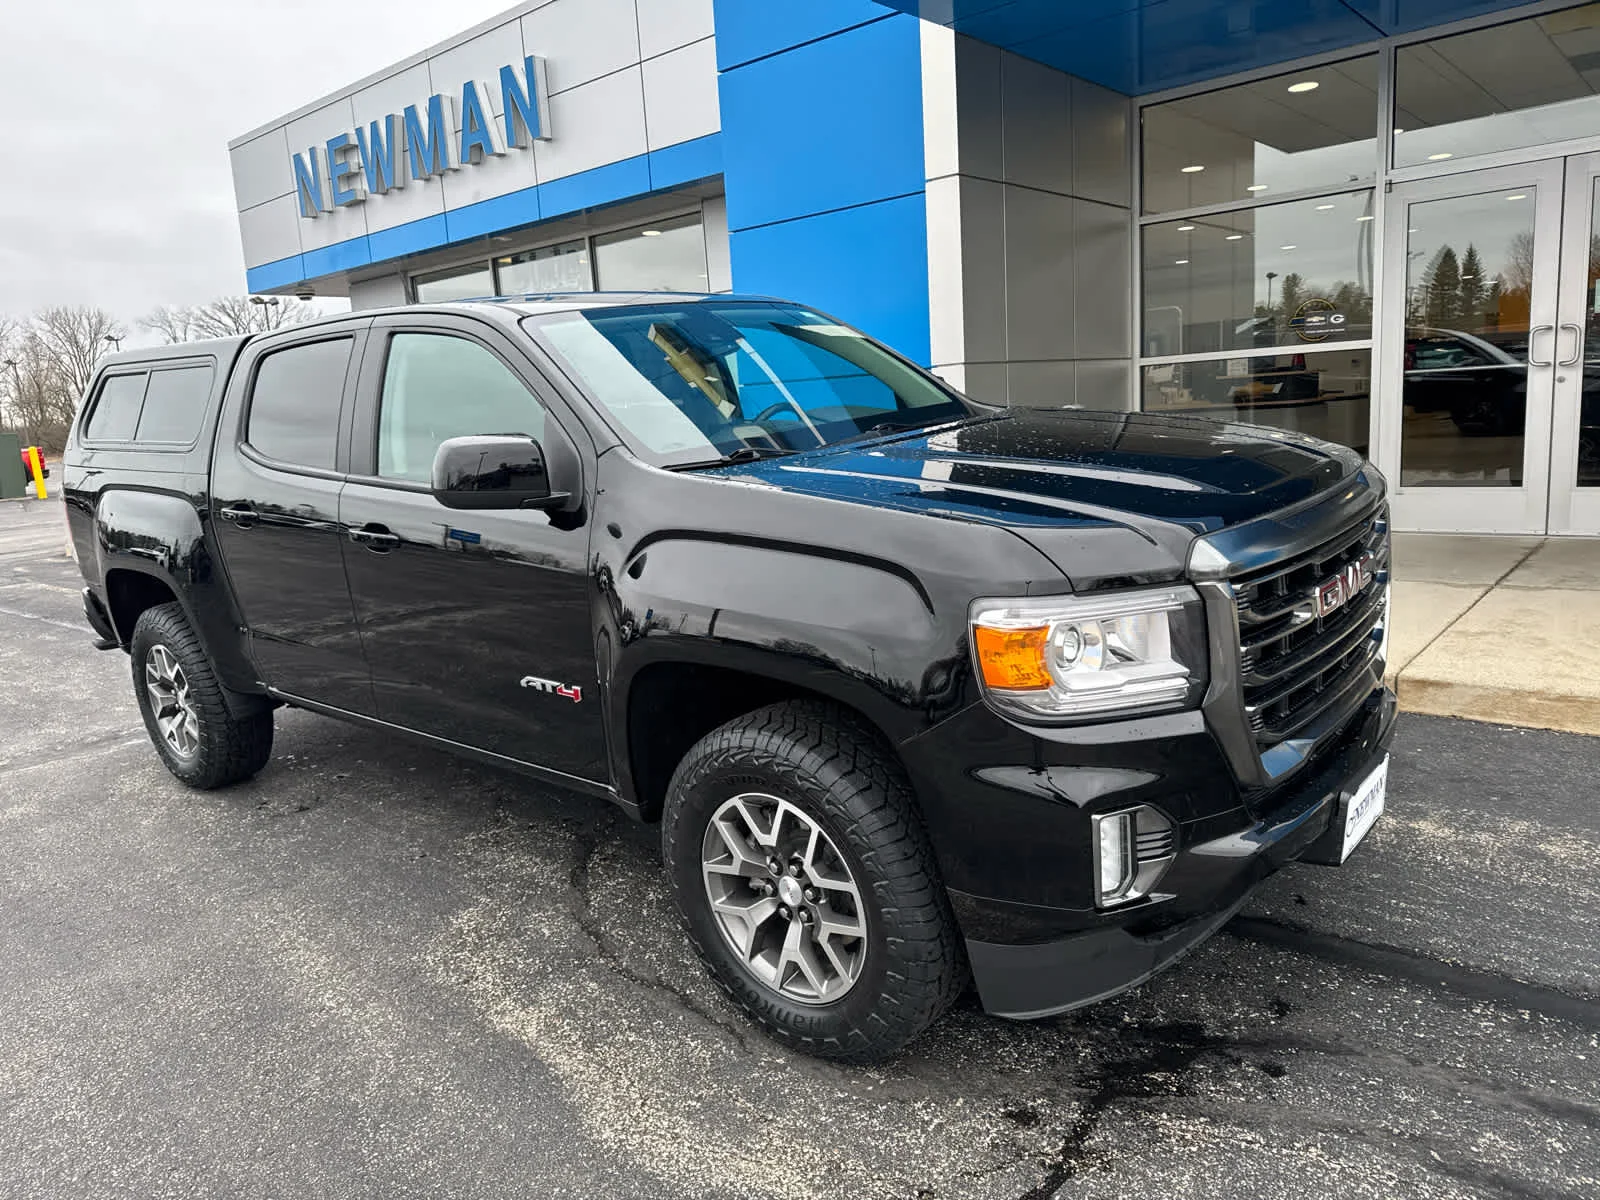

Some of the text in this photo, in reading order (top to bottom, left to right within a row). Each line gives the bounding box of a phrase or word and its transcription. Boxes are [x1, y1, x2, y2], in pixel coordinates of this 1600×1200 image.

[293, 55, 552, 218] NEWMAN
[1318, 553, 1374, 618] GMC
[520, 675, 582, 703] AT4
